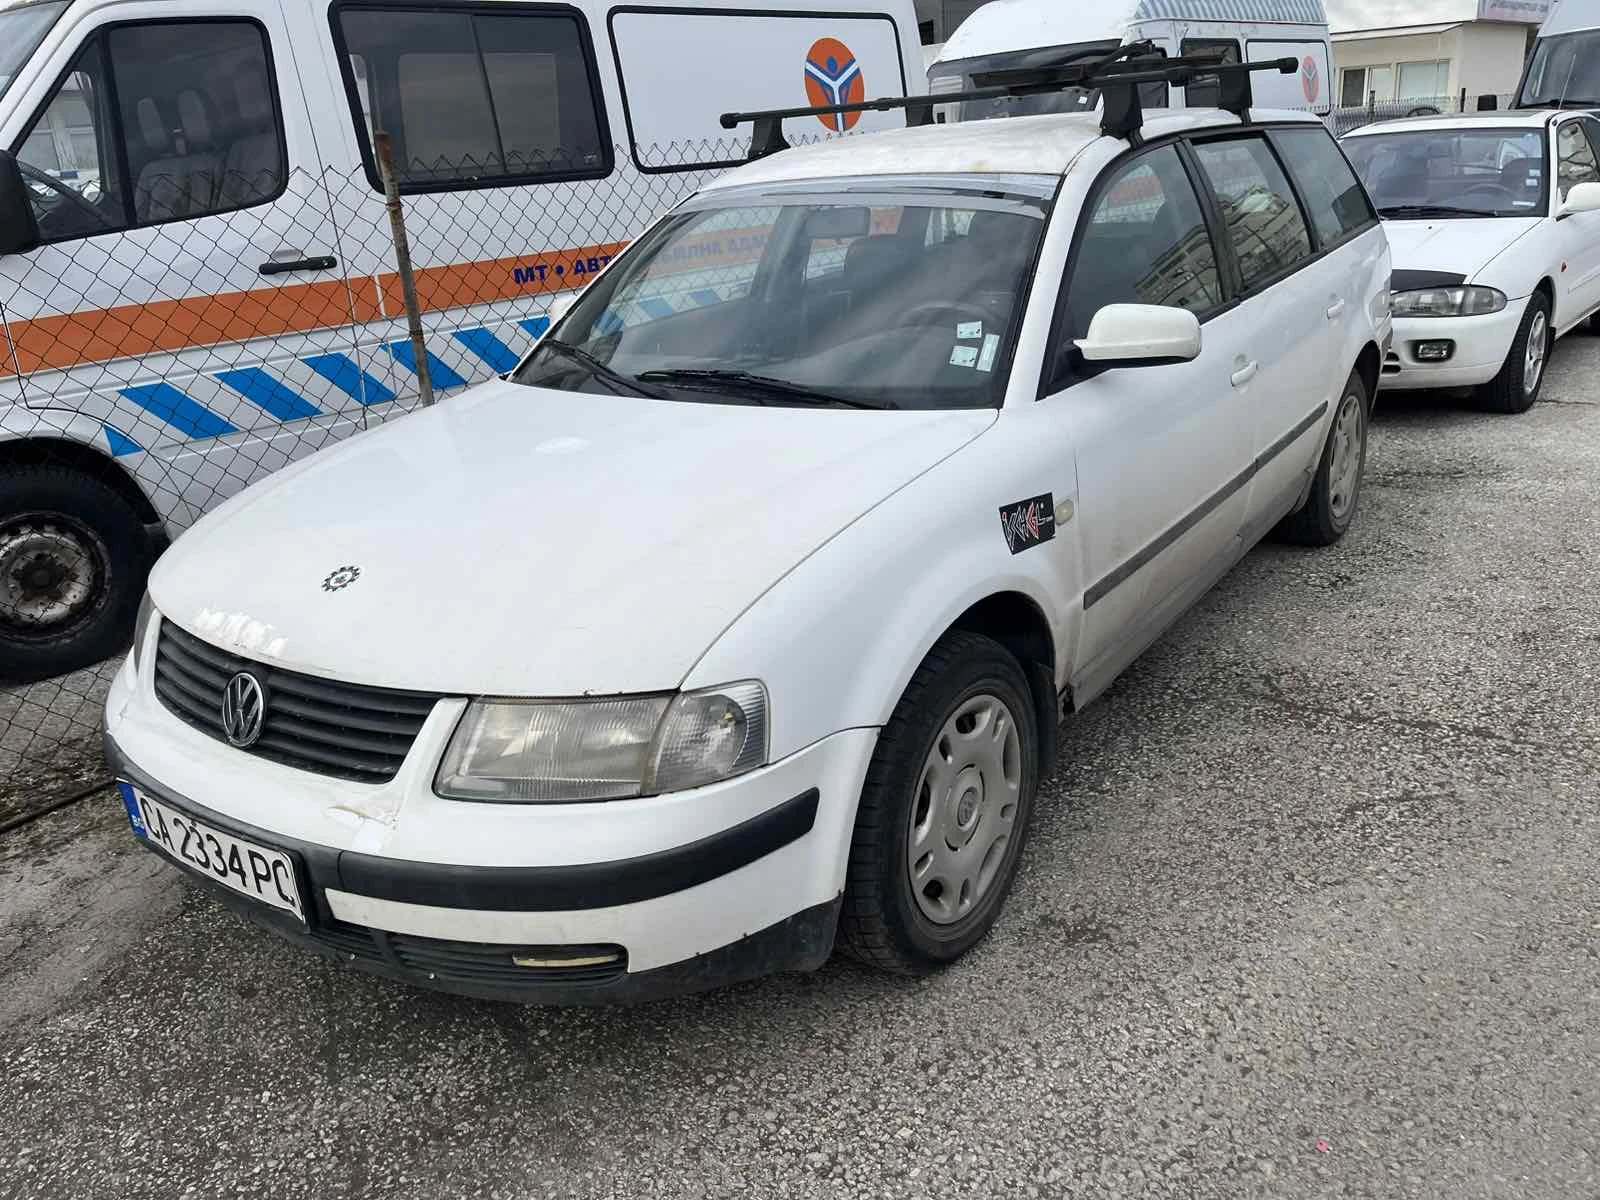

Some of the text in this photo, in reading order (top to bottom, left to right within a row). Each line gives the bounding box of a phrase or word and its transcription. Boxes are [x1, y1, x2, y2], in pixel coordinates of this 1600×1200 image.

[513, 264, 548, 285] МТ
[140, 797, 176, 852] CA
[173, 817, 247, 888] 2334
